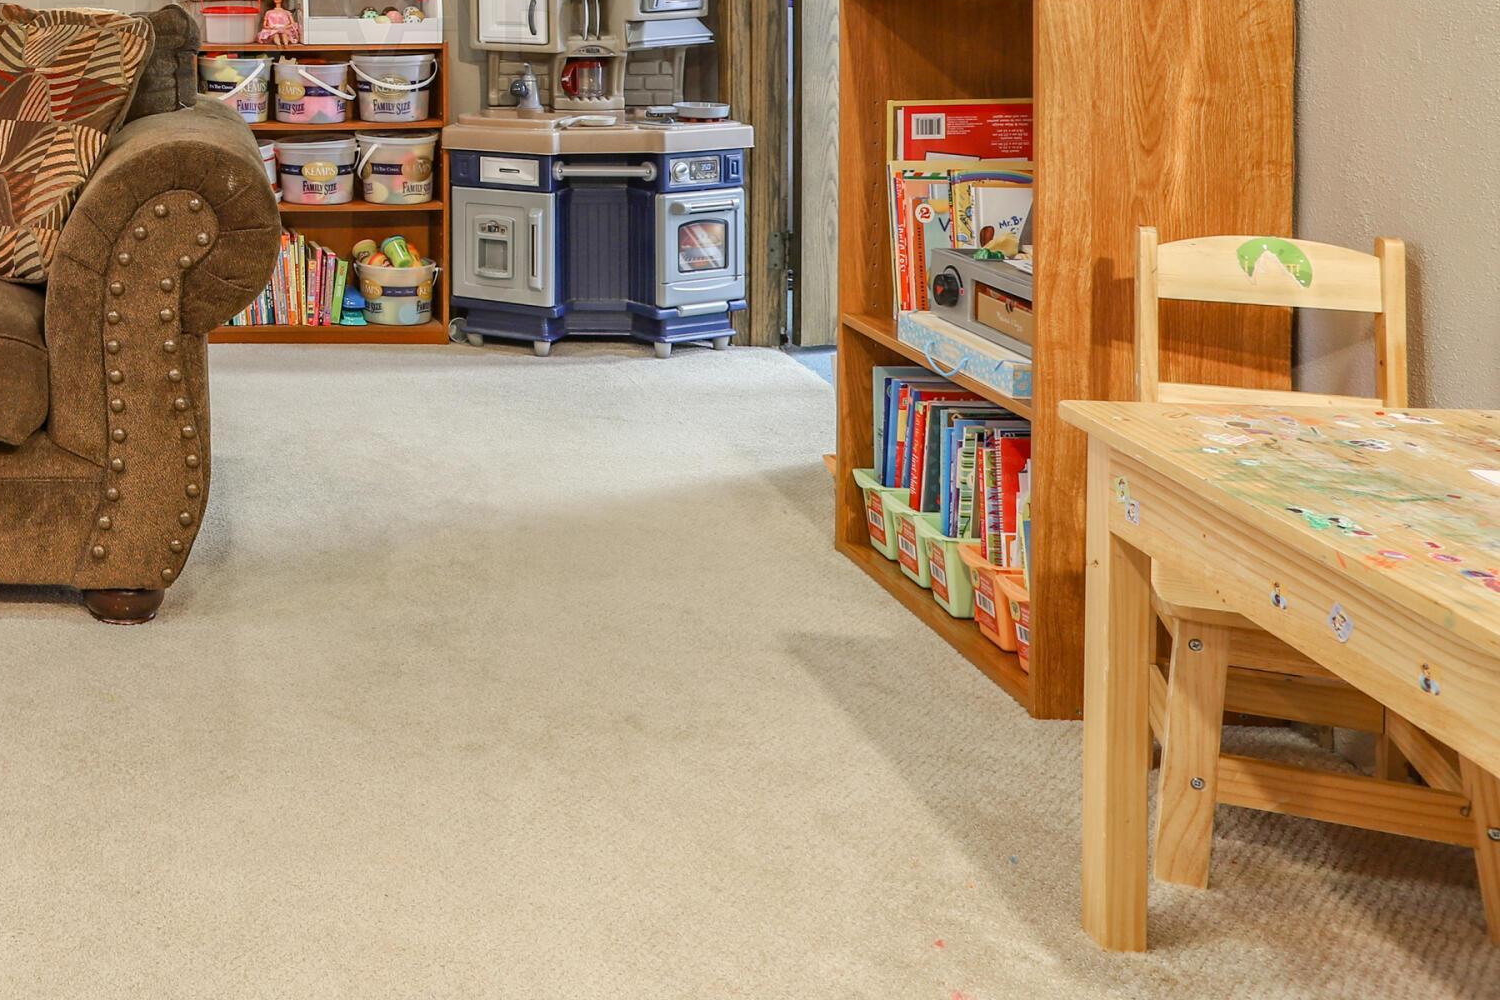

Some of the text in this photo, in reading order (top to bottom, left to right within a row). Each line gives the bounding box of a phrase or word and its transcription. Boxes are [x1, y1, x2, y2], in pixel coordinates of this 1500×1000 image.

[236, 99, 257, 112] FAMILY
[292, 103, 304, 115] SIZE
[372, 98, 411, 116] FAMILY SIZE
[304, 166, 336, 177] KEMPS
[302, 180, 338, 196] FAMILY SIZE
